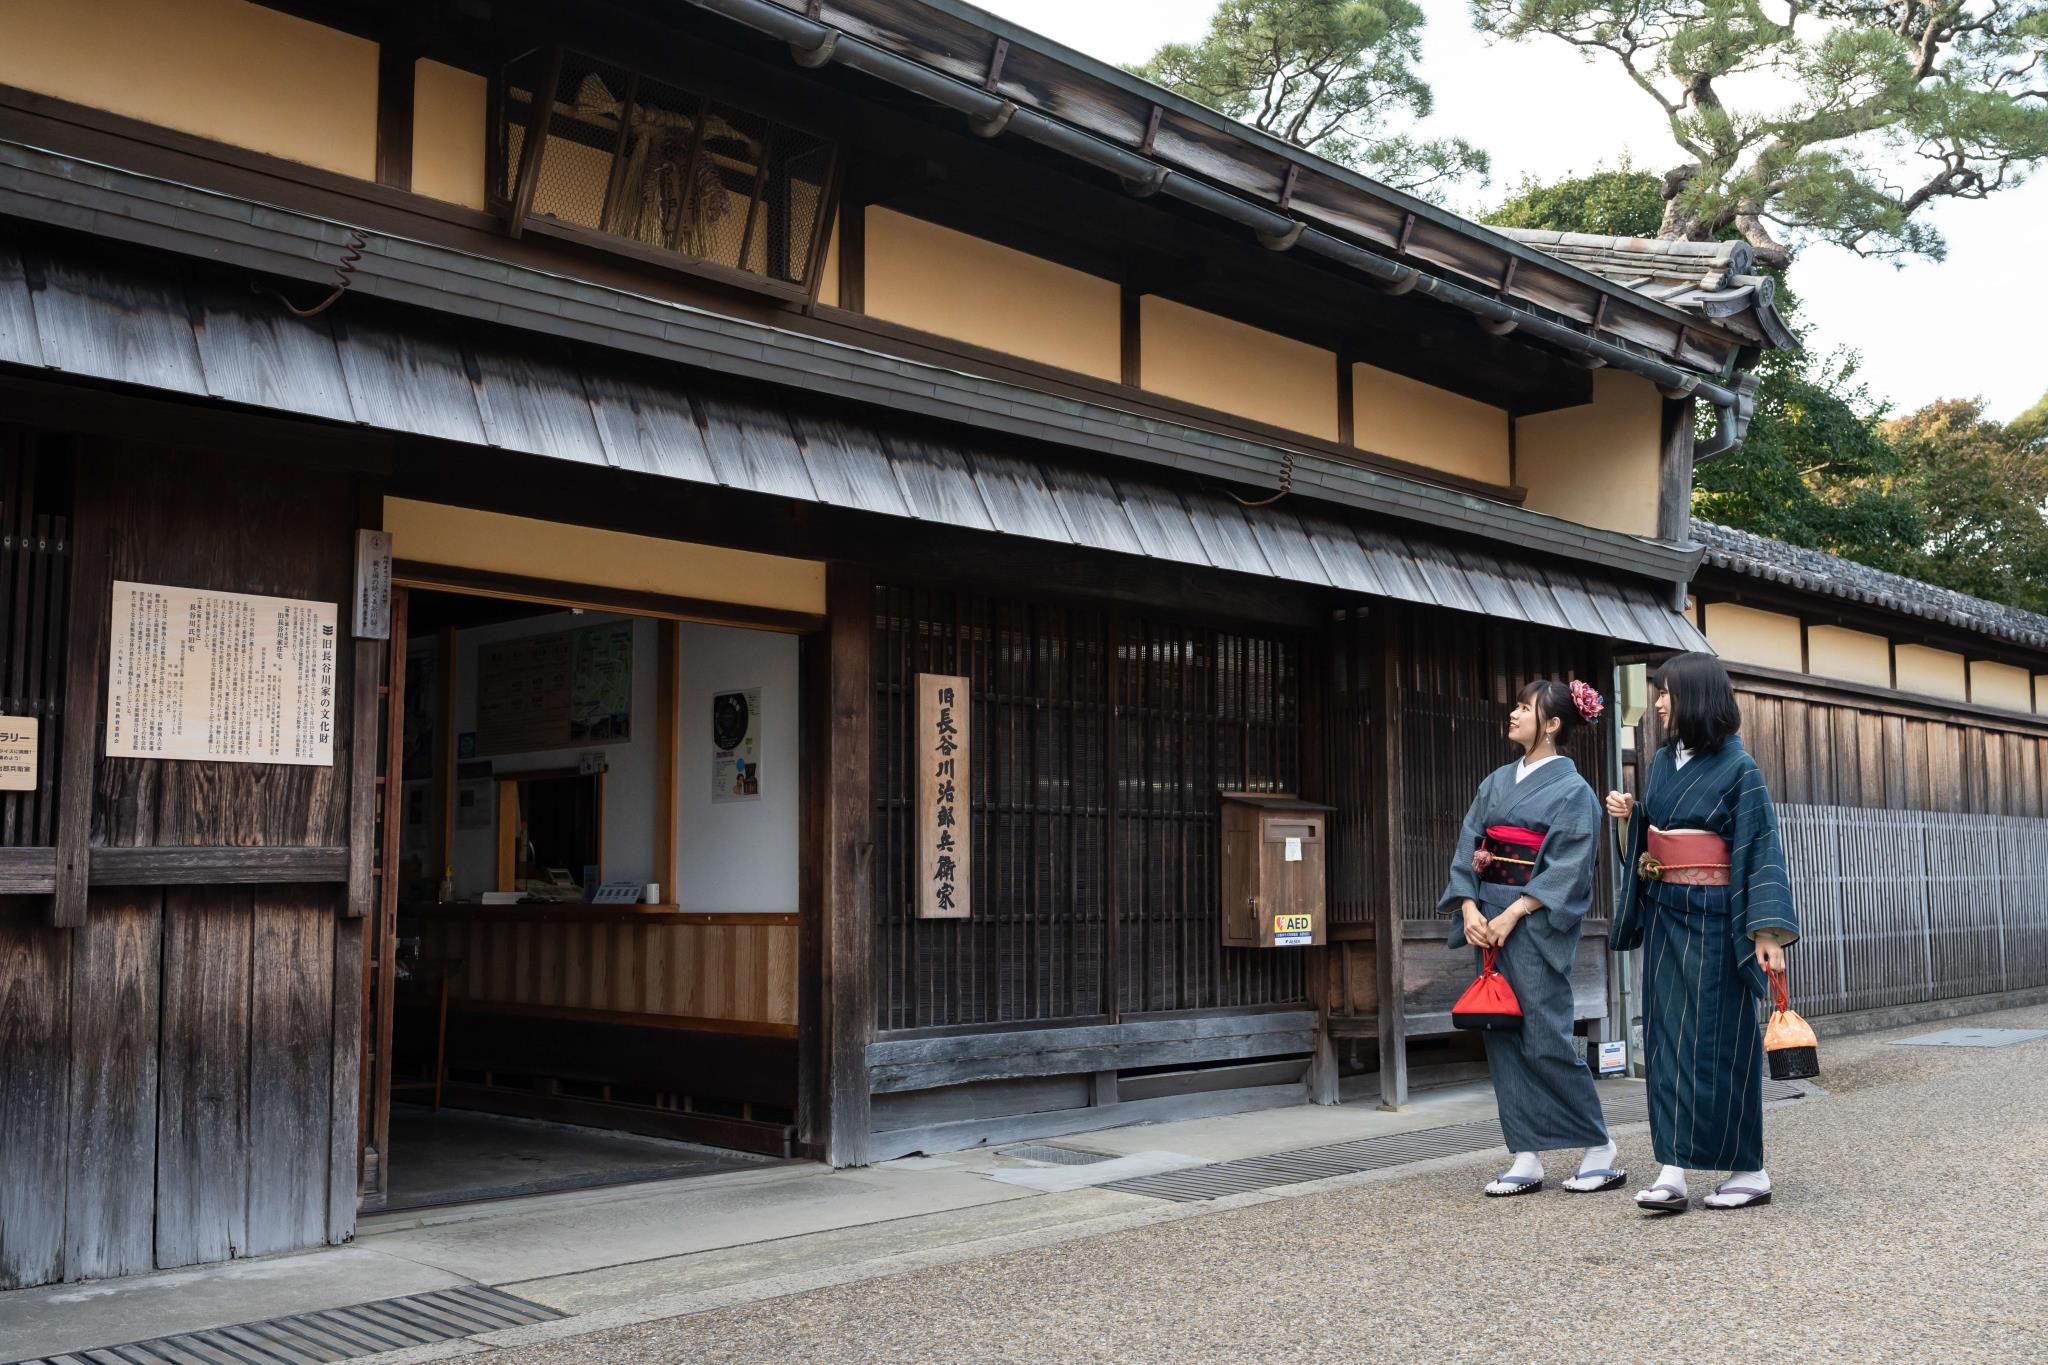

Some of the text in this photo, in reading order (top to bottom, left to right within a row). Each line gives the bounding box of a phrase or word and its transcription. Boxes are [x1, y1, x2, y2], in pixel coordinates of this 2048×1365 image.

[188, 603, 196, 652] 長谷川氏旧宅
[276, 612, 284, 659] 旧長谷川家住宅
[320, 639, 332, 743] 旧長谷川家の文化財
[933, 687, 958, 910] 旧長谷川治郎兵衛家
[1287, 917, 1309, 930] AED
